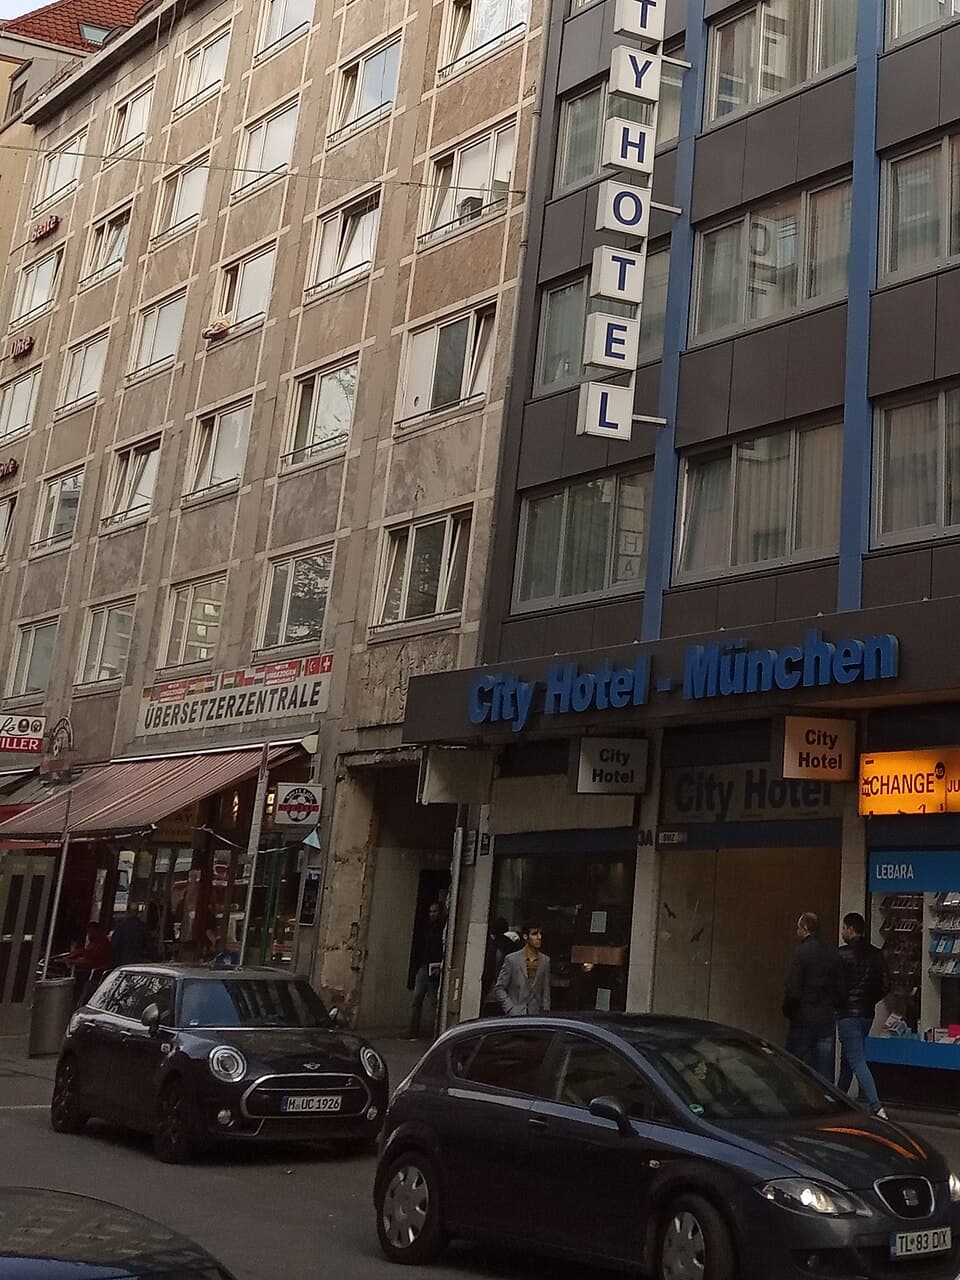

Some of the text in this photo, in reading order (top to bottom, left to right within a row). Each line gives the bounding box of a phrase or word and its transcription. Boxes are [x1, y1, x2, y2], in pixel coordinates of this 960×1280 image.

[469, 671, 534, 733] City
[545, 653, 652, 716] Hotel
[682, 626, 900, 699] München
[145, 680, 322, 729] ÜBERSETZERZENTRALE
[805, 729, 838, 751] City
[599, 747, 630, 768] City
[798, 751, 842, 770] Hotel
[591, 768, 635, 784] Hotel
[673, 768, 831, 821] City Hotel
[876, 863, 915, 880] LEBARA
[288, 1098, 340, 1110] M UC 1926
[898, 1235, 912, 1253] TL
[916, 1233, 929, 1251] 83
